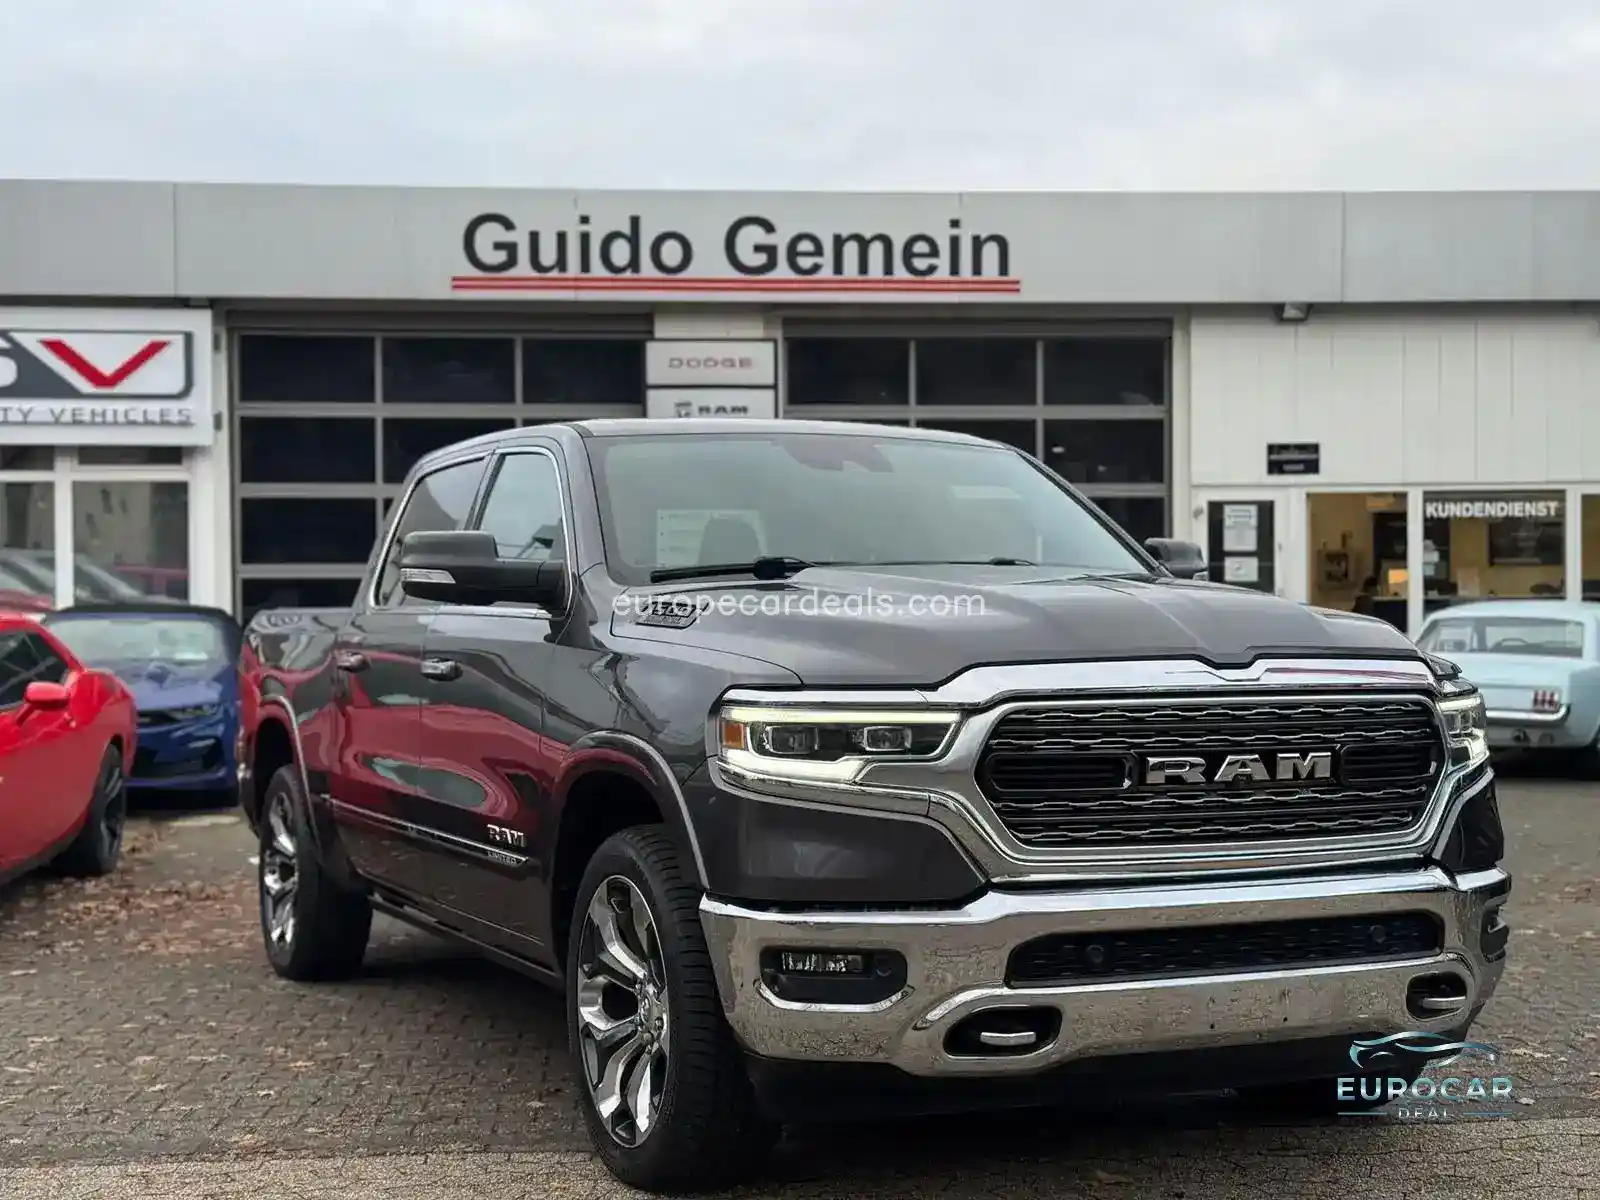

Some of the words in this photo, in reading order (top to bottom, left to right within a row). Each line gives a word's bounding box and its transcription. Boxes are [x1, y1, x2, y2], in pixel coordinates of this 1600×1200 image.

[463, 212, 694, 276] Guido
[723, 216, 1010, 278] Gemein
[668, 357, 753, 369] DODGE
[50, 407, 193, 426] VEHICLES
[698, 405, 749, 415] RAM
[1425, 501, 1559, 518] KUNDENDIENST
[1146, 752, 1332, 784] RAM
